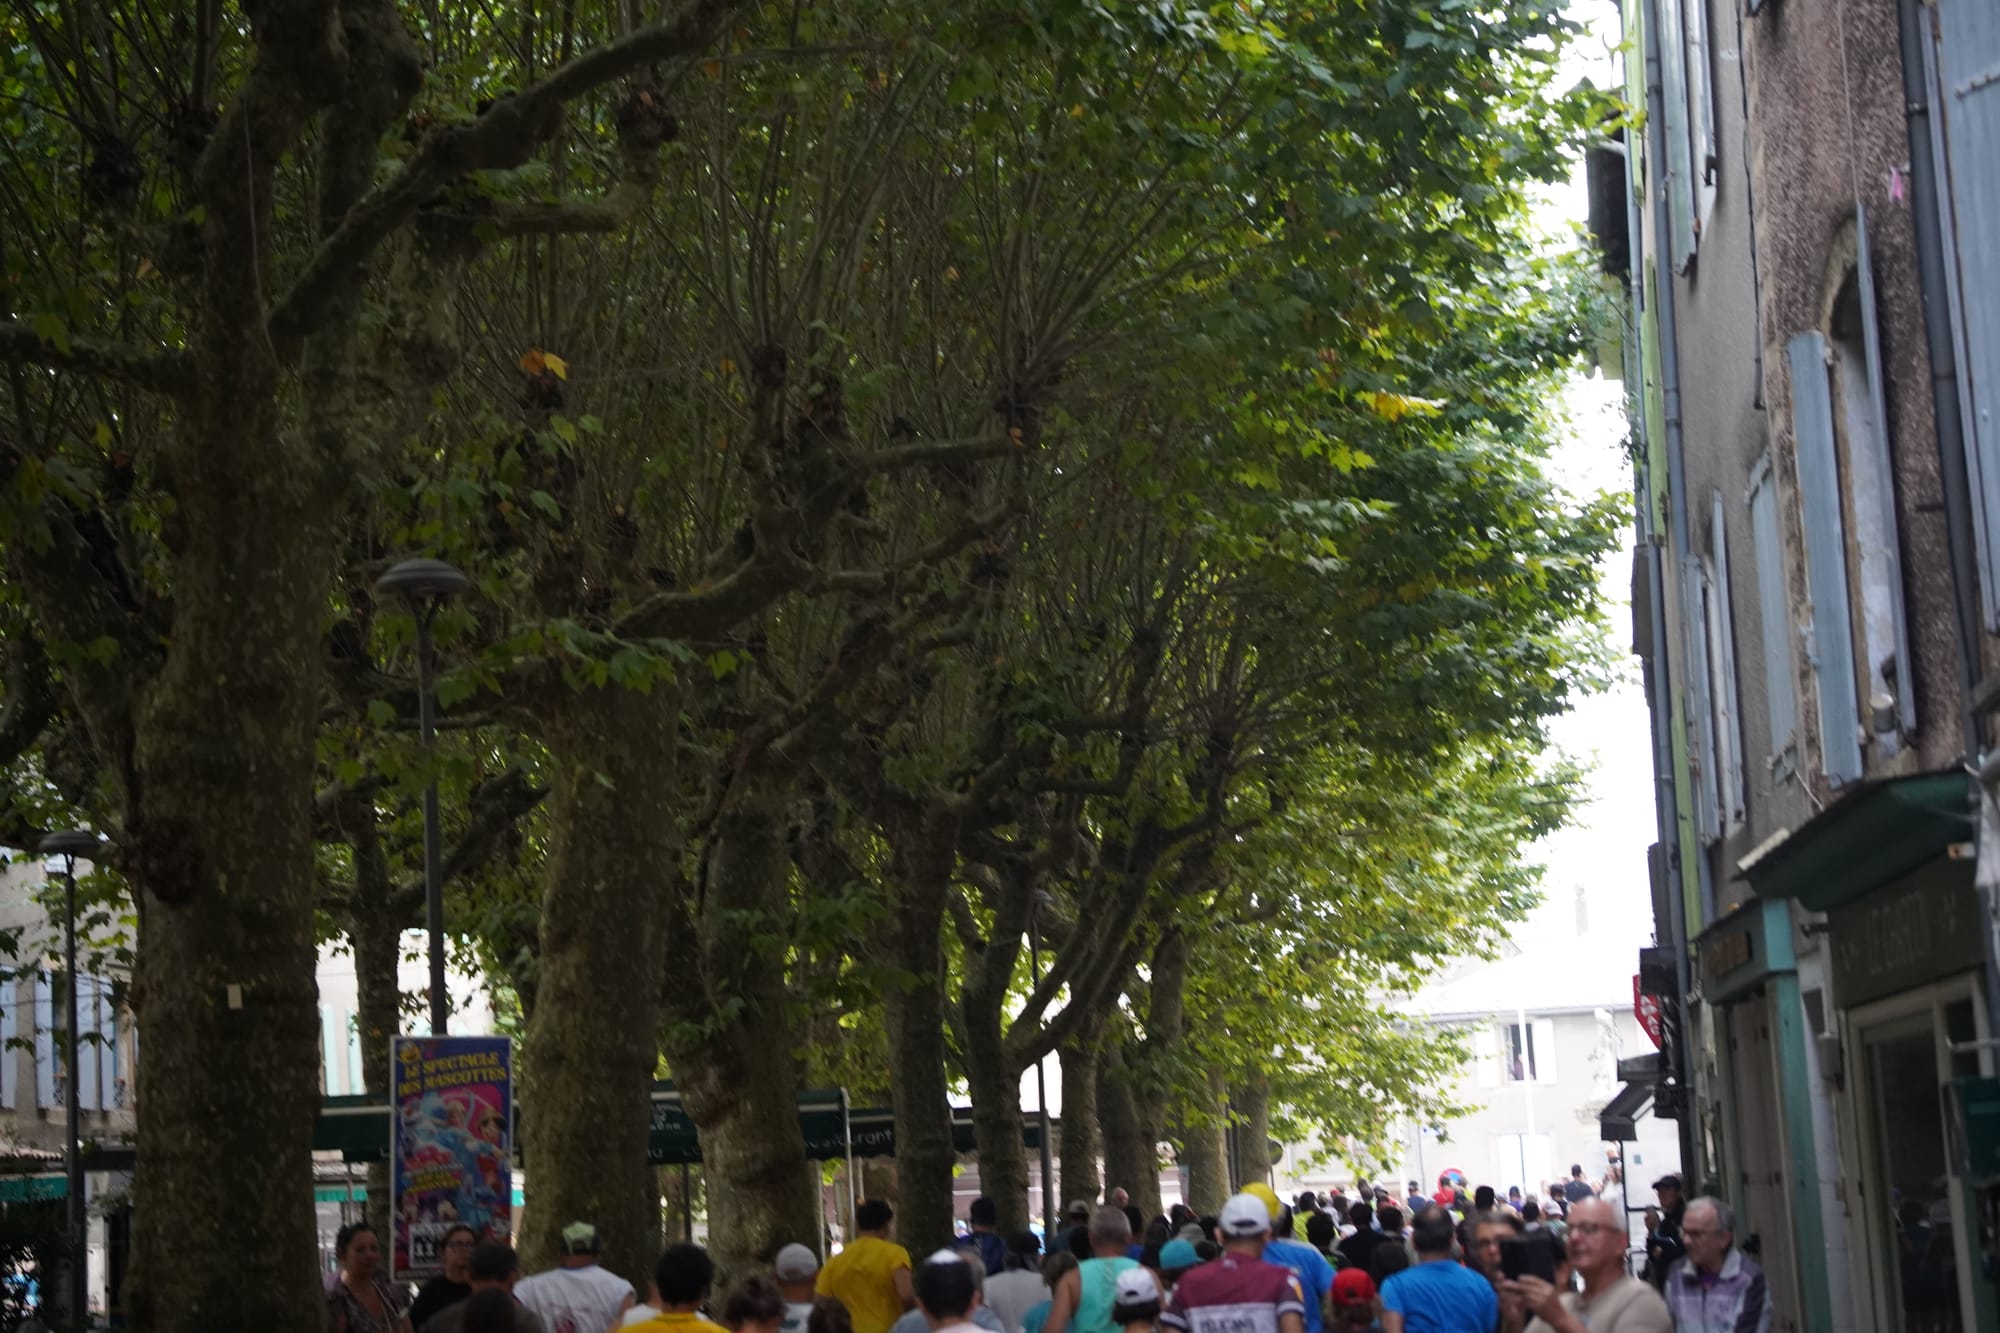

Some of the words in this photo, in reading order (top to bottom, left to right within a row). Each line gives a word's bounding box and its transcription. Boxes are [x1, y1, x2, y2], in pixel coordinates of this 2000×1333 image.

[405, 1065, 420, 1079] LE
[423, 1052, 499, 1073] SPECTACLE
[399, 1080, 421, 1096] DES
[424, 1068, 507, 1088] MASCOTTES
